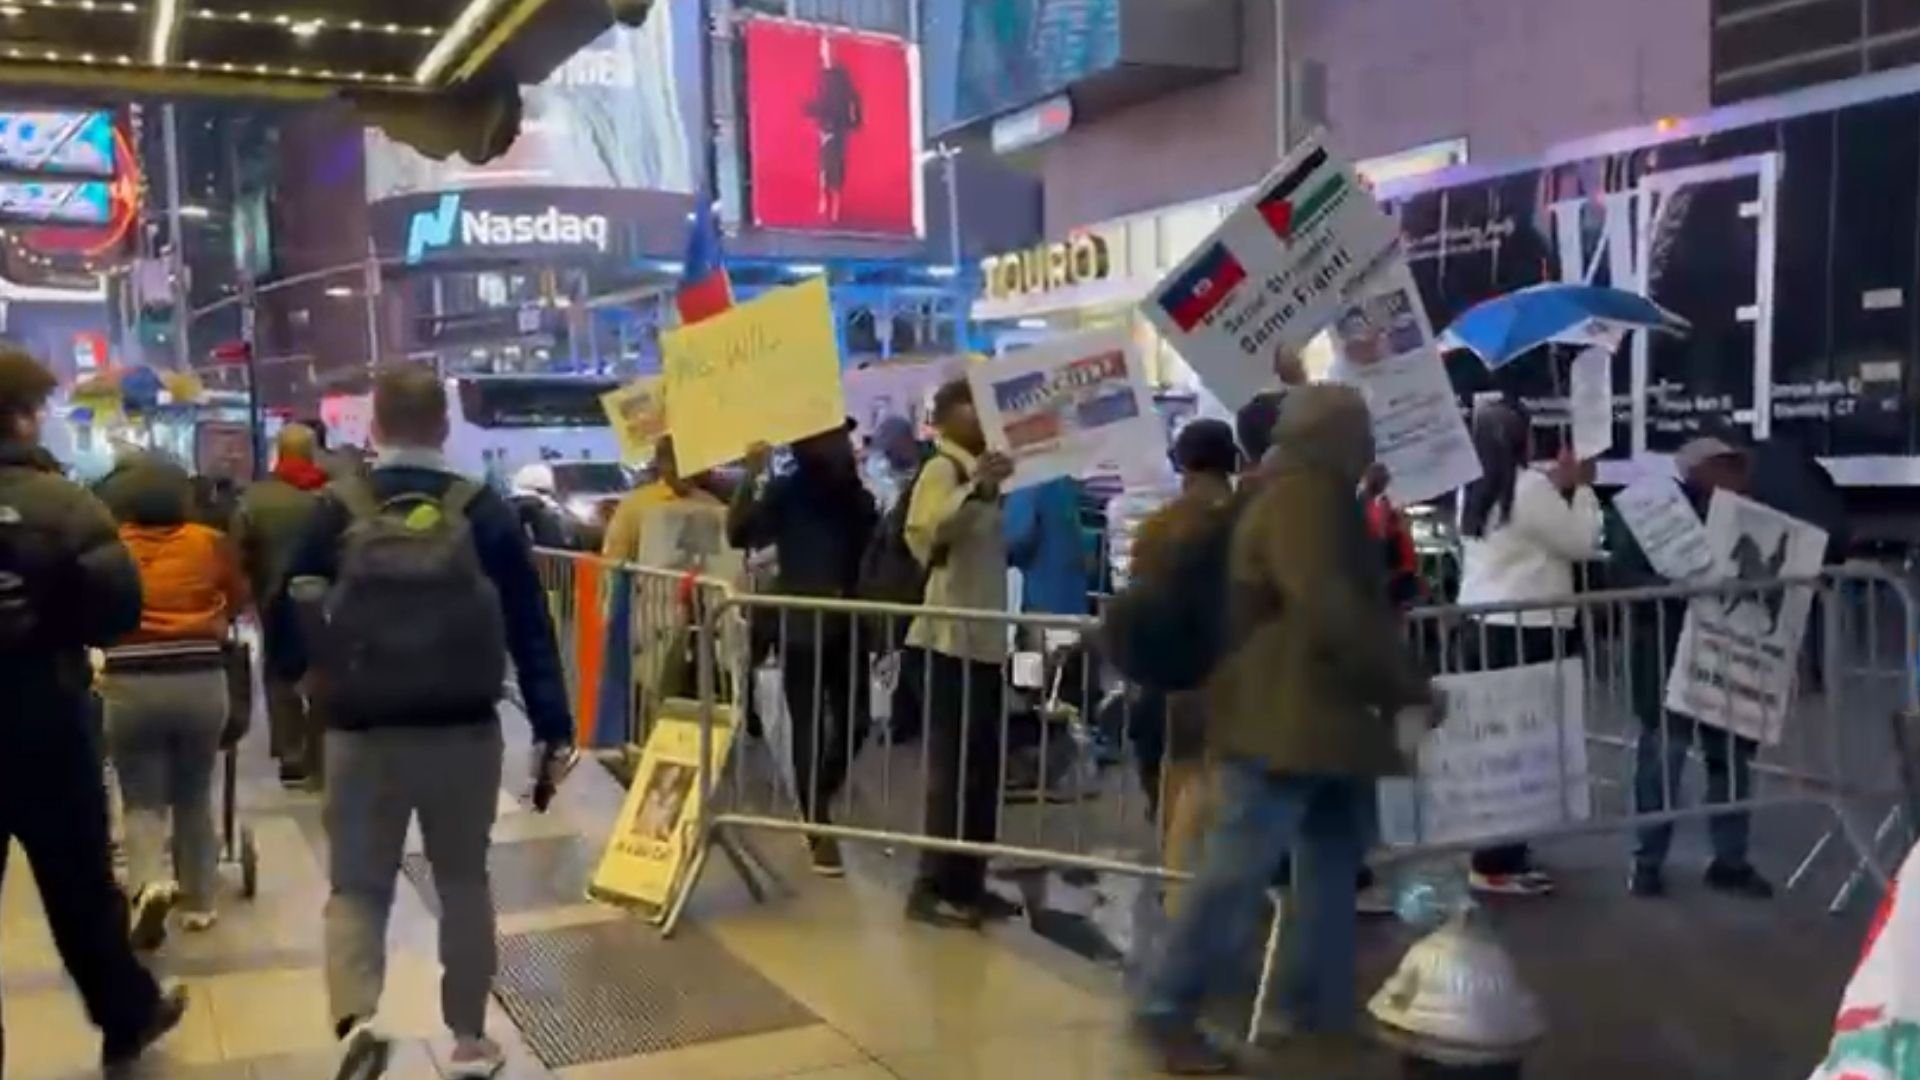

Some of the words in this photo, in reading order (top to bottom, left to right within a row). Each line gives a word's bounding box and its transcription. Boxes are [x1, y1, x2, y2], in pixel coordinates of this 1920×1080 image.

[461, 206, 607, 251] Nasdaq
[979, 225, 1099, 298] TOURO
[1240, 302, 1296, 354] Same
